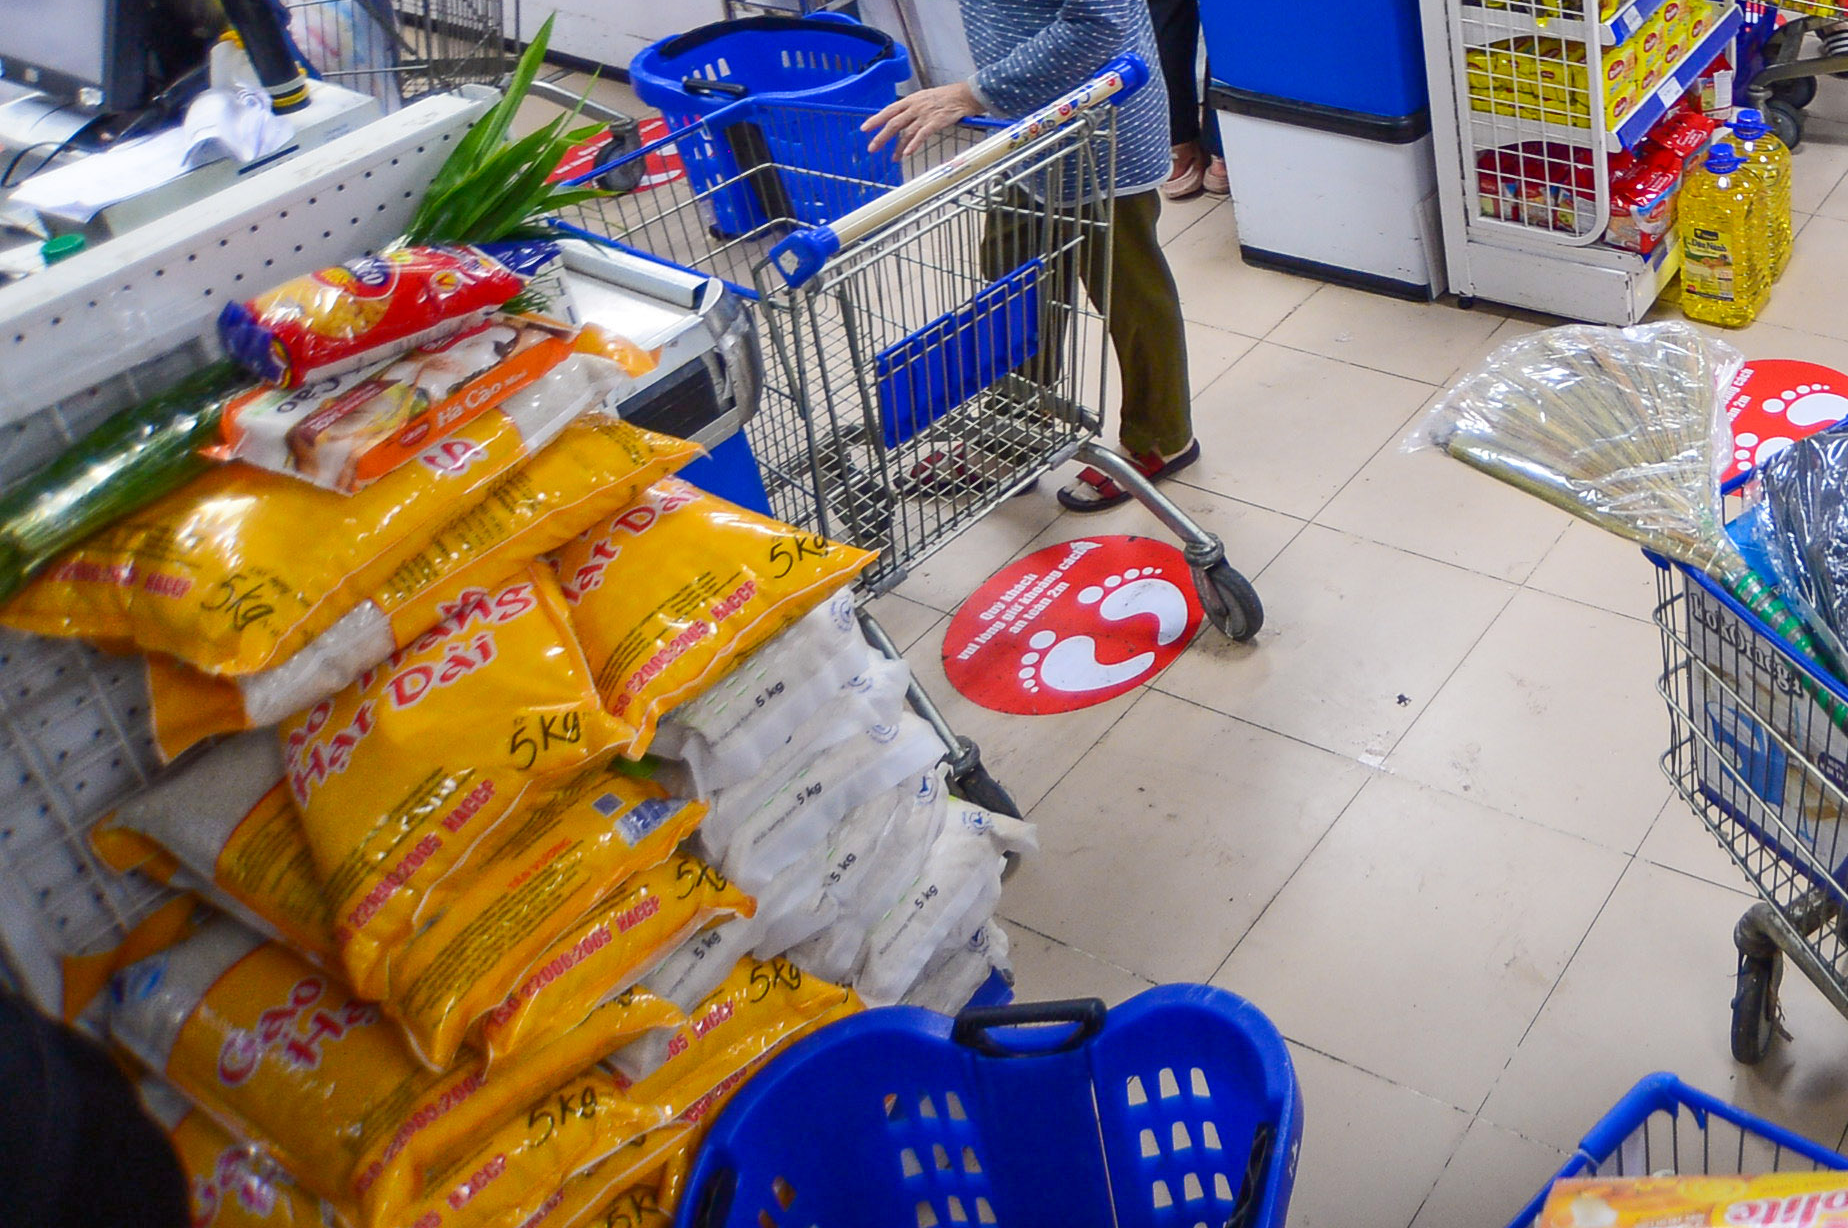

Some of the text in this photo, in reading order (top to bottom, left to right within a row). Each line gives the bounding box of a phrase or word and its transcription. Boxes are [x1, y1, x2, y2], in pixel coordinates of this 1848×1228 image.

[710, 579, 757, 622] HACCP
[977, 620, 1007, 645] lòng
[1018, 569, 1064, 605] khoảng
[978, 572, 1039, 622] Quý khách
[1008, 580, 1072, 636] an toàn 2m
[766, 680, 786, 700] kg
[806, 781, 824, 799] kg
[838, 852, 858, 871] kg
[921, 883, 940, 902] kg
[615, 894, 661, 935] HACCP
[700, 931, 723, 949] kg
